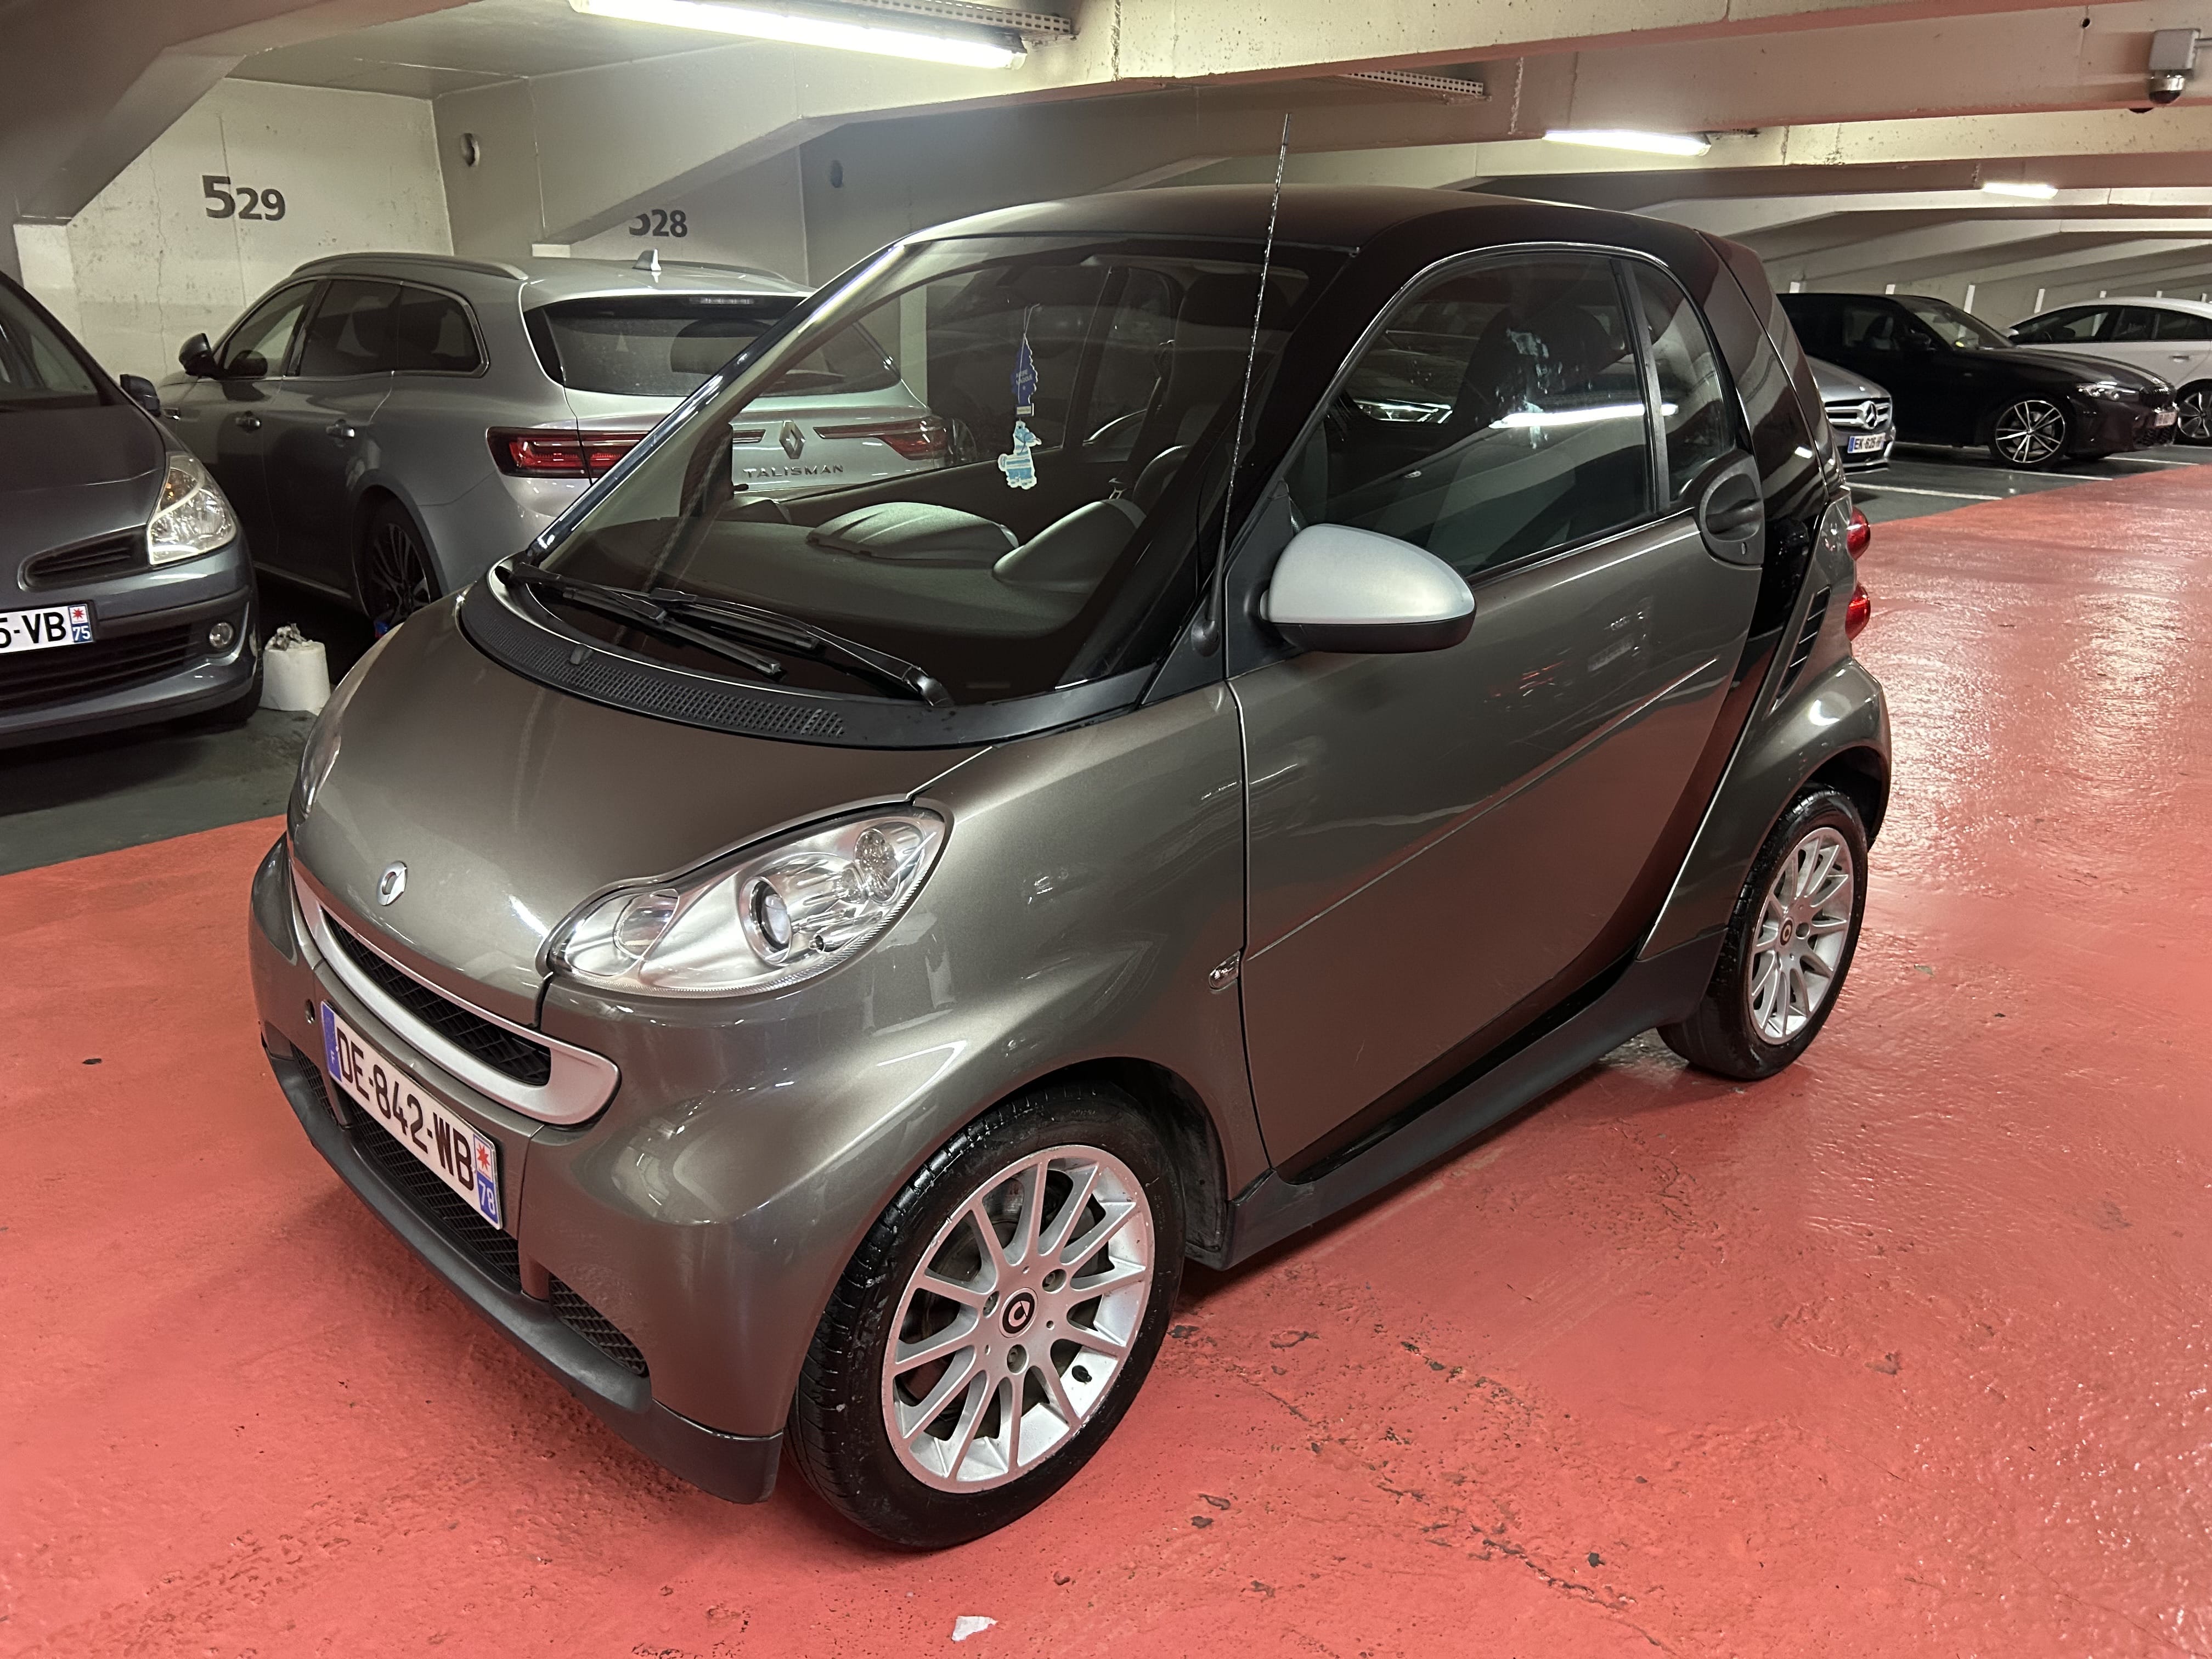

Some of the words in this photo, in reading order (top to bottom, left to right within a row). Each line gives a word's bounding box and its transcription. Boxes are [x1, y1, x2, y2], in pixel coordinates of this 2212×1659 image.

[202, 175, 285, 221] 529
[743, 465, 844, 478] TALISMAN
[72, 625, 91, 641] 75
[330, 1050, 335, 1065] F
[336, 1027, 474, 1191] DE-842-WB
[478, 1180, 495, 1215] 78
